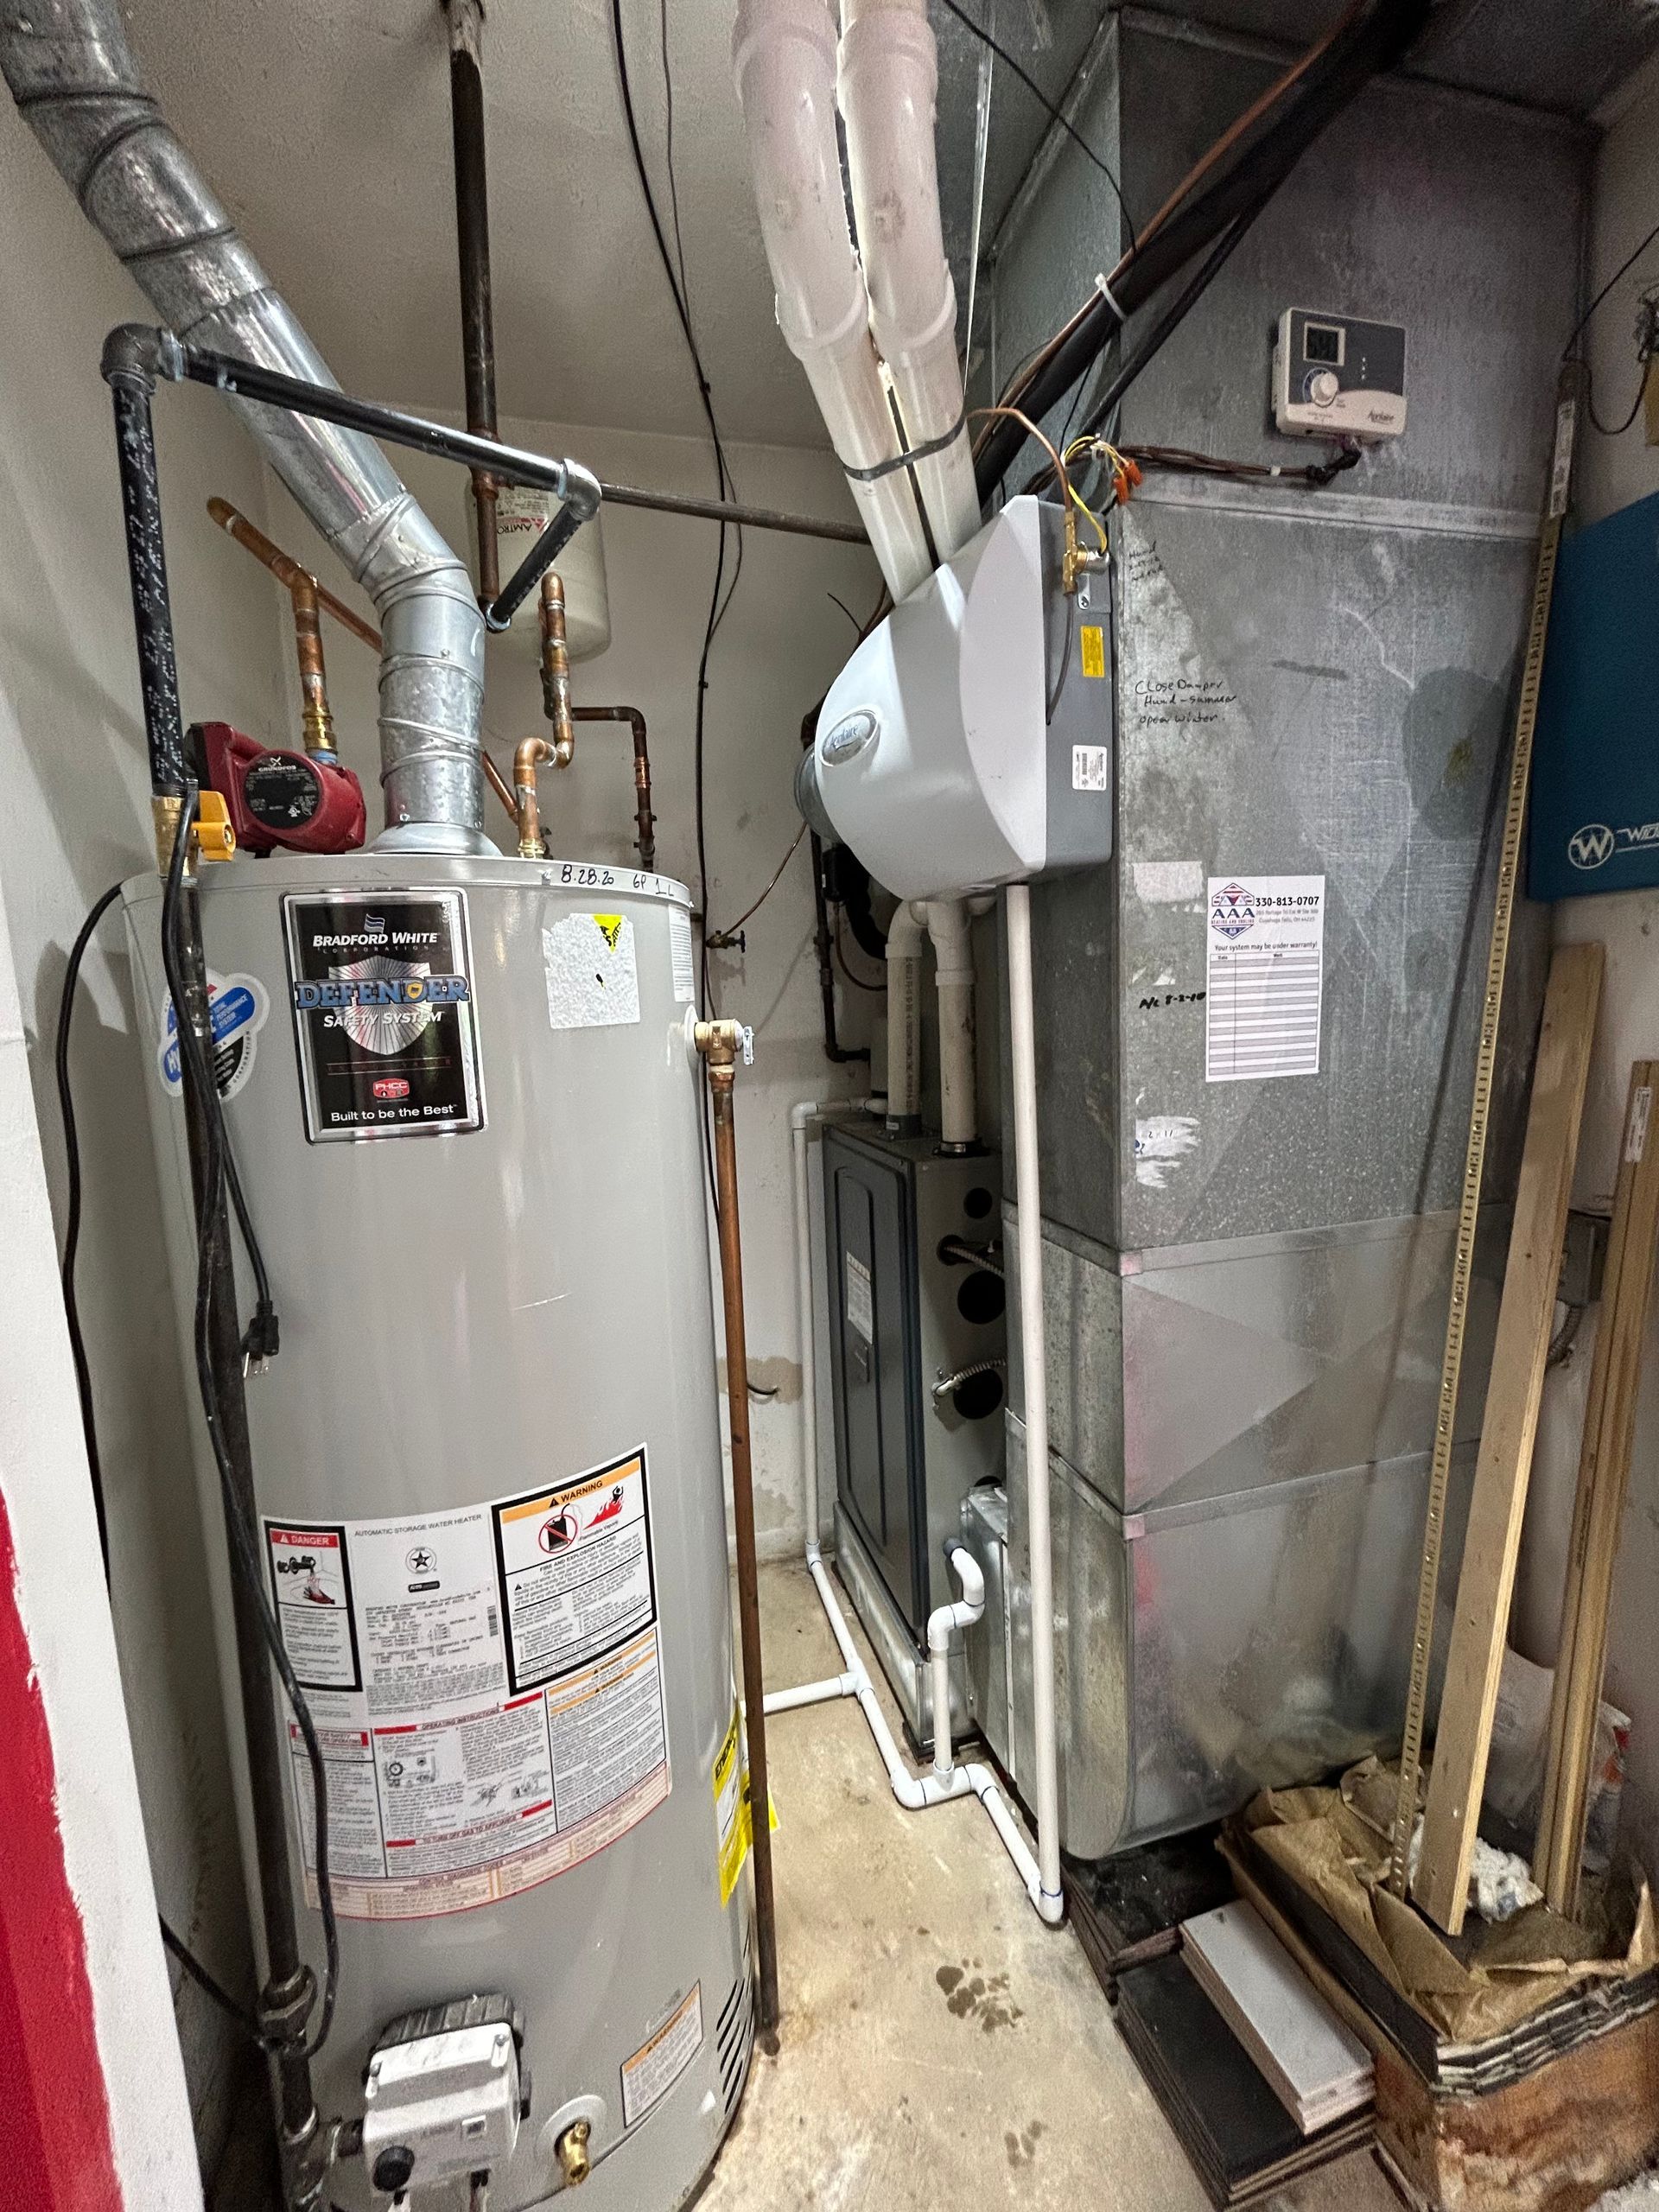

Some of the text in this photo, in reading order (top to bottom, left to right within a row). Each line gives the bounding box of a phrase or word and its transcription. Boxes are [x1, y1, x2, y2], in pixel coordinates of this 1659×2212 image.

[1255, 896, 1319, 906] 330-813-0707
[313, 932, 438, 947] BRADFORD WHITE
[294, 974, 470, 1009] DEFENDER
[323, 1014, 378, 1027] SAFETY
[375, 1082, 408, 1090] PHCC
[331, 1104, 454, 1122] Built to be the Best
[561, 1480, 603, 1503] WARNING
[354, 1514, 482, 1536] AUTOMATIC STORAGE WATER HEATER
[290, 1535, 330, 1546] DANGER
[540, 1563, 553, 1572] FIRE
[566, 1548, 594, 1563] EXPLOSION
[595, 1535, 617, 1550] HAZARD
